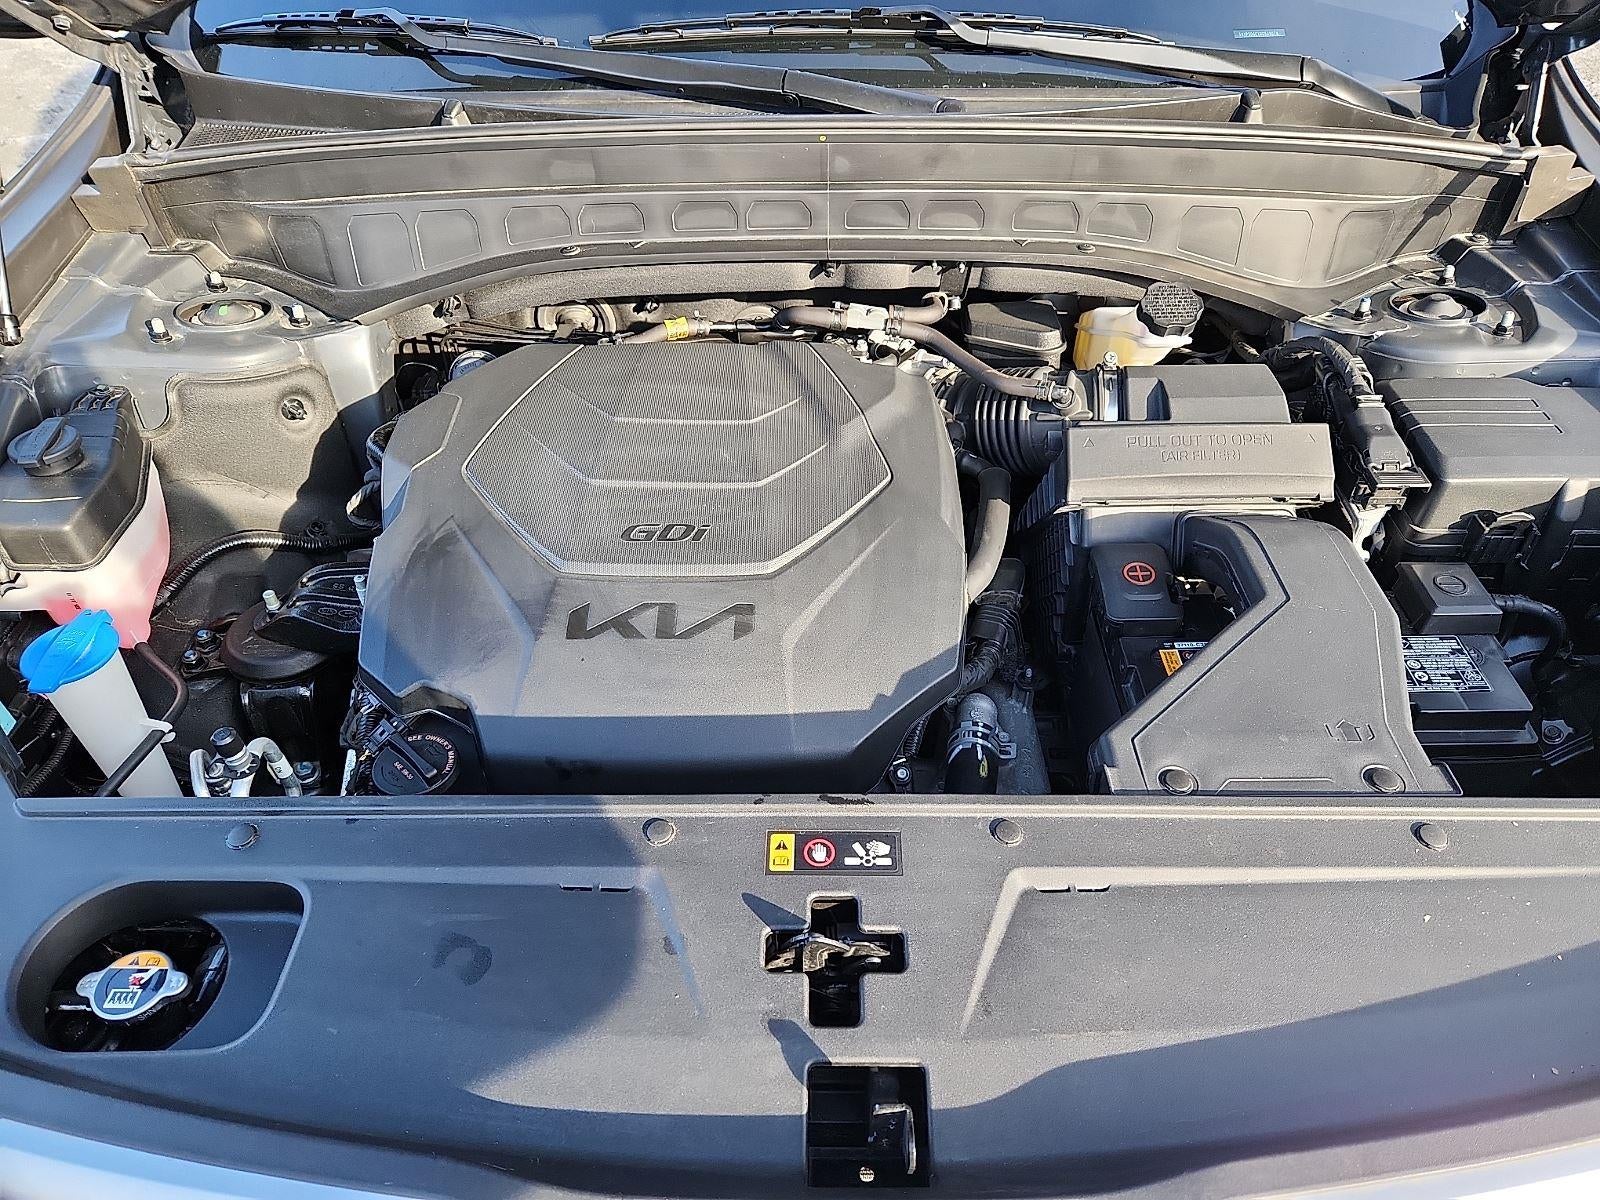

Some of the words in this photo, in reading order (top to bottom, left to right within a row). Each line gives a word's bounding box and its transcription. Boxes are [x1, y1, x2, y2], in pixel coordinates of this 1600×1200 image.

[1126, 435, 1165, 448] PULL
[1170, 434, 1202, 447] OUT
[1209, 434, 1227, 446] TO
[1232, 433, 1274, 446] OPEN
[1161, 449, 1189, 462] (AIR
[620, 523, 712, 542] GDi
[565, 601, 756, 641] KIA
[407, 734, 423, 742] SEE
[441, 750, 455, 774] MANUAL
